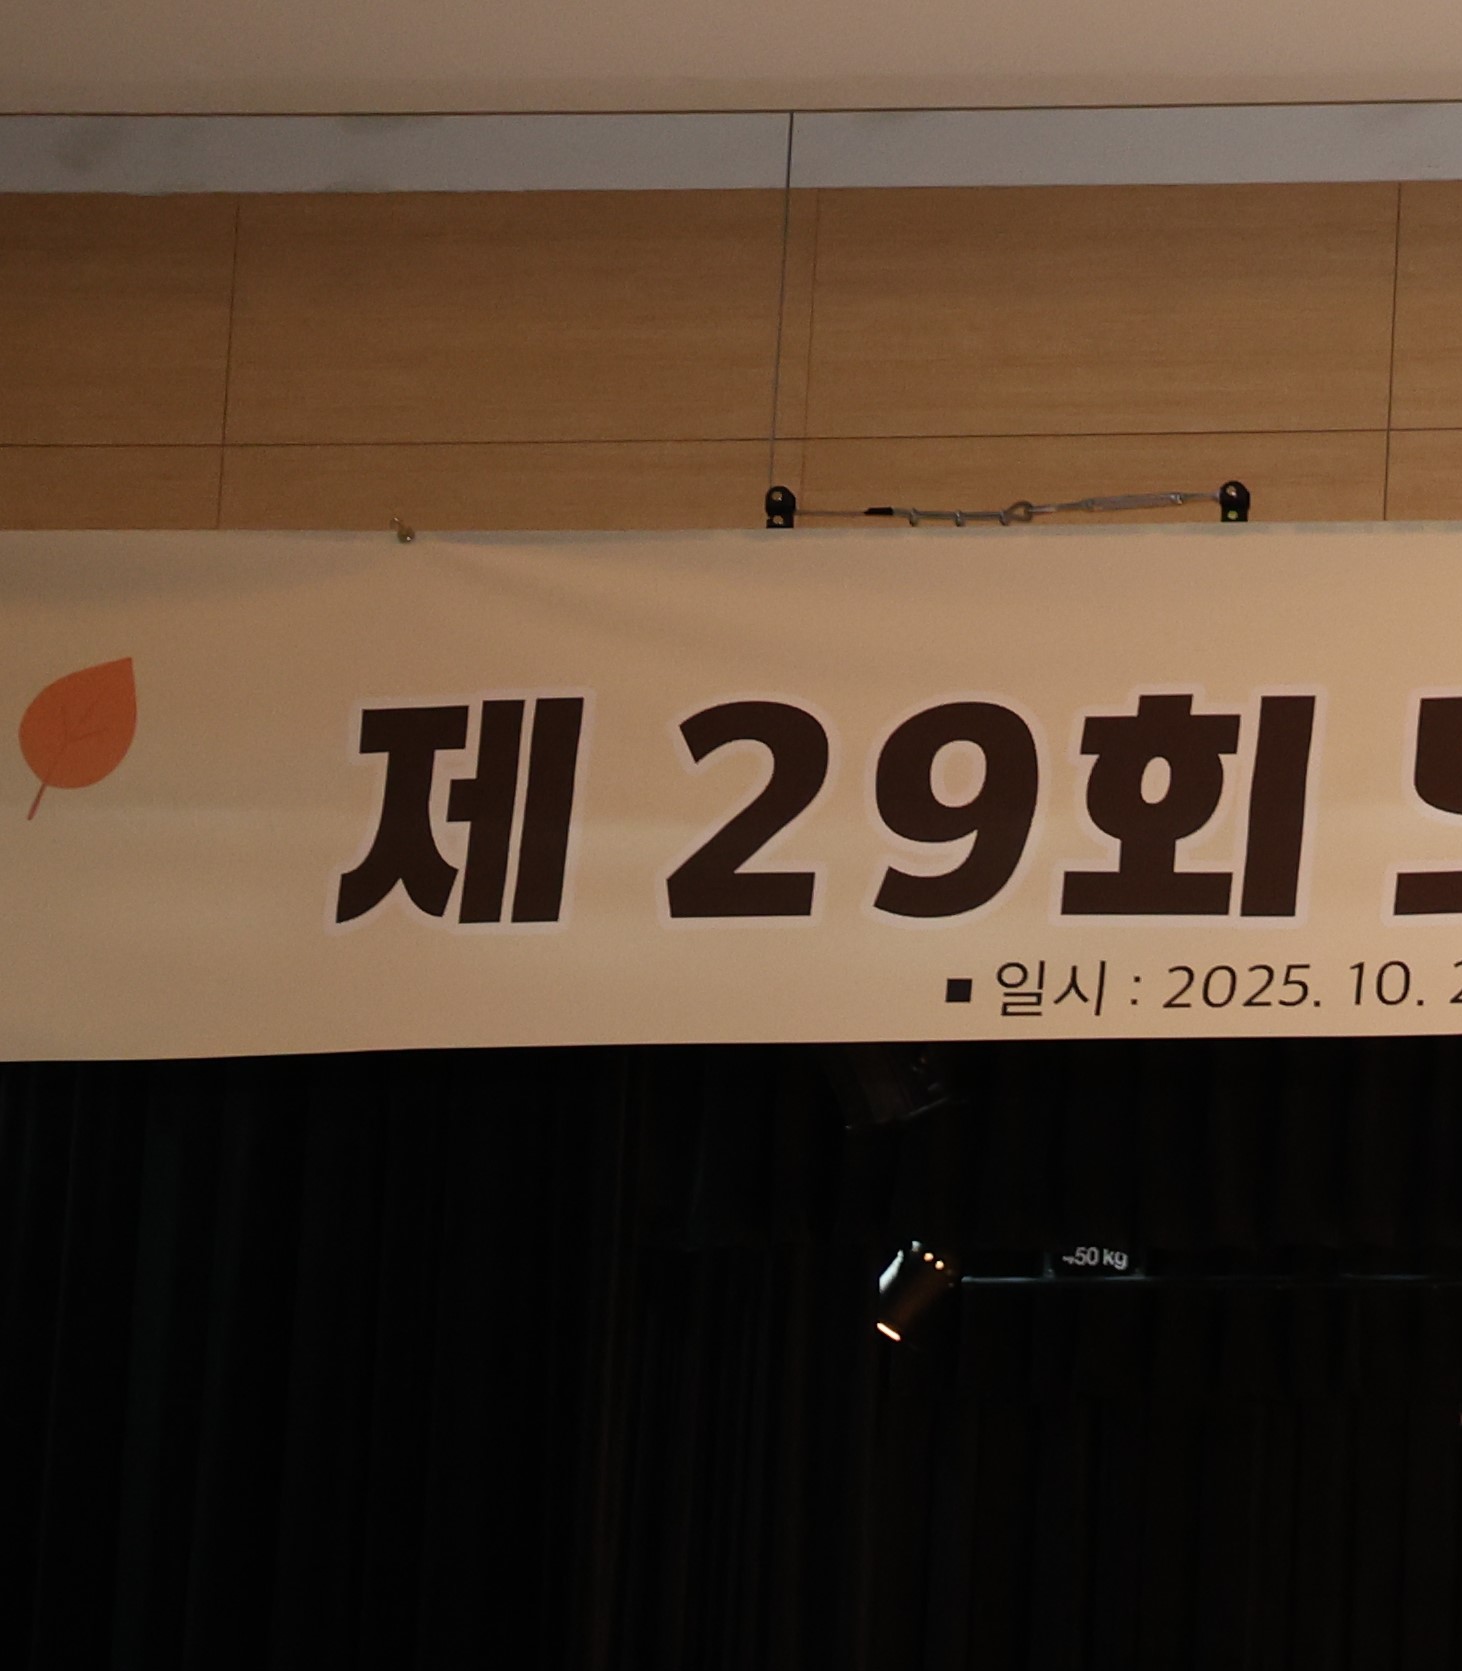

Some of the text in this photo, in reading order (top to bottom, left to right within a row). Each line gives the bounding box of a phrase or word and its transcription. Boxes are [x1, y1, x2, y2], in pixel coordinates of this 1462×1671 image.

[336, 698, 583, 923] 제
[667, 694, 1315, 918] 29회
[997, 961, 1105, 1016] 일시
[1163, 965, 1320, 1008] 2025.
[1351, 961, 1423, 1005] 10.
[1103, 1249, 1127, 1269] kg
